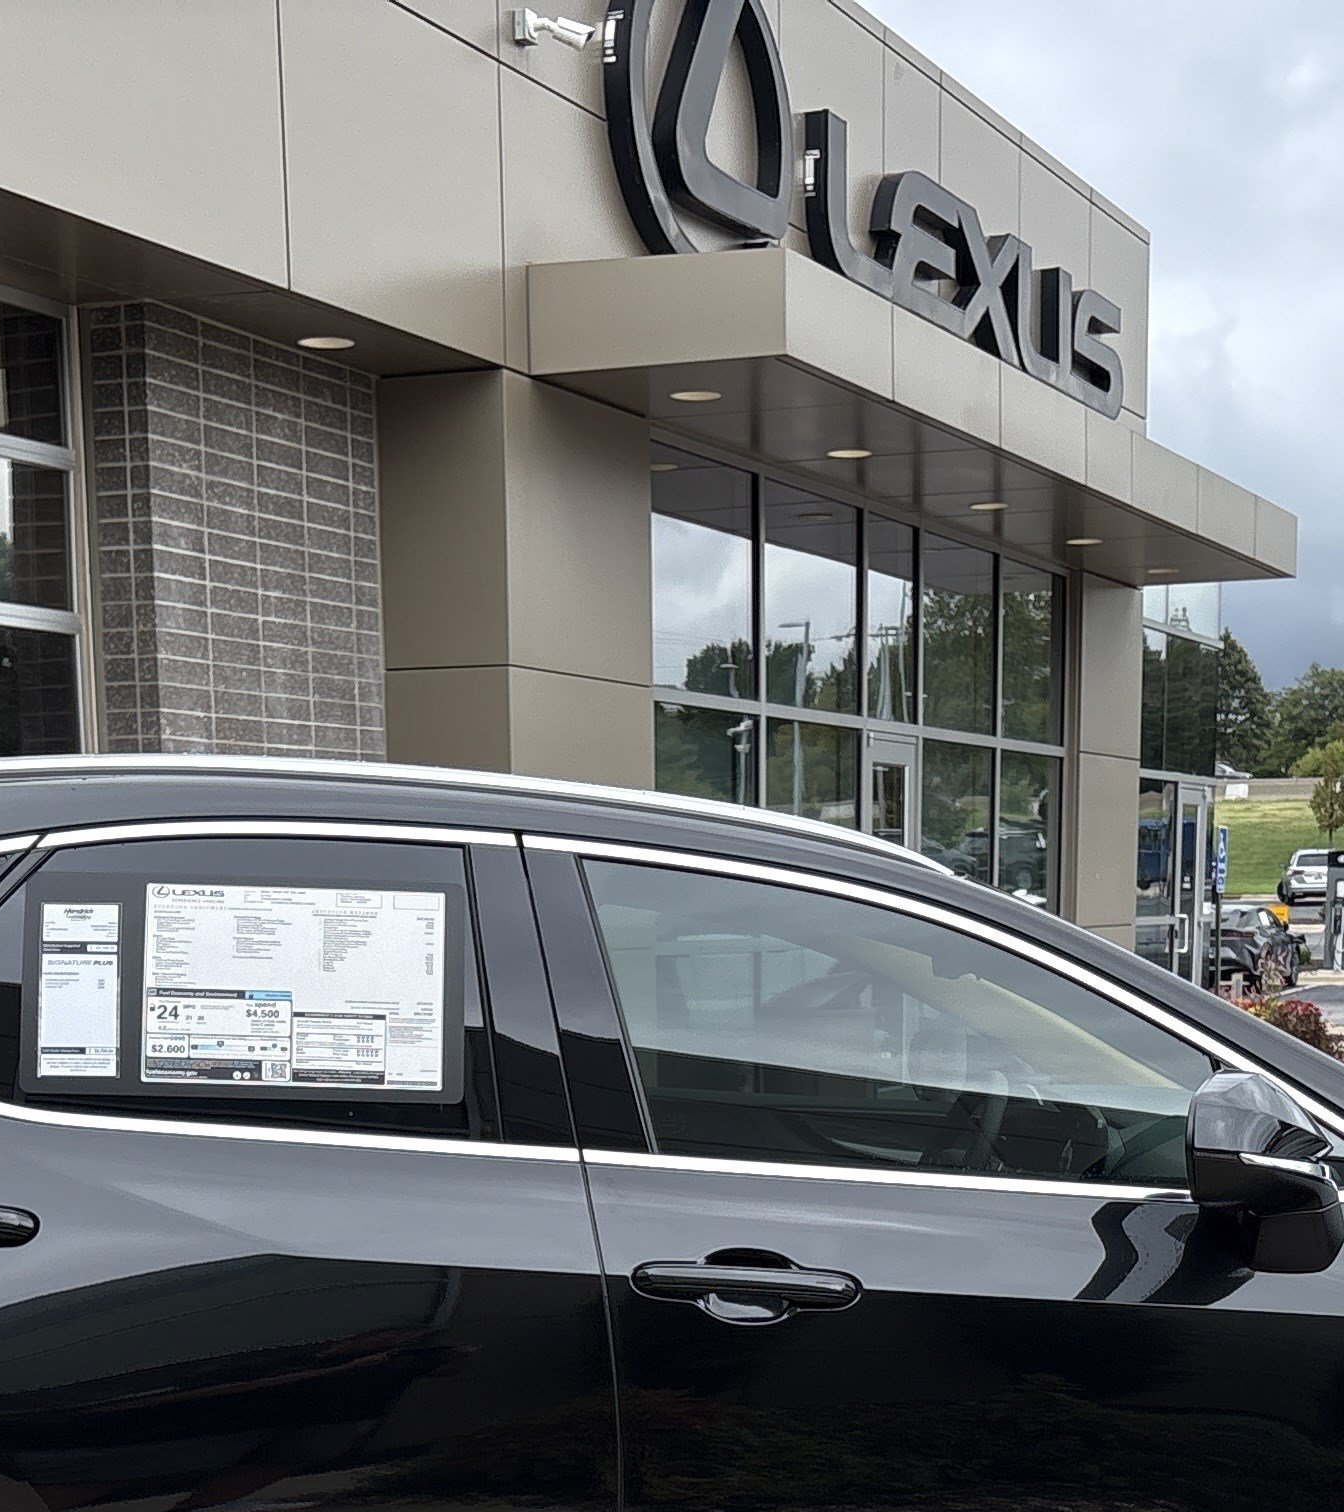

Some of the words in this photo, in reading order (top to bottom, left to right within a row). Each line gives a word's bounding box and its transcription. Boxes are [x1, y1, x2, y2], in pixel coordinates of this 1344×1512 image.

[804, 108, 1125, 420] LEXUS
[171, 888, 225, 898] LEXUS
[156, 1004, 180, 1021] 24
[245, 1008, 280, 1019] $4,500
[150, 1043, 186, 1054] $2,600
